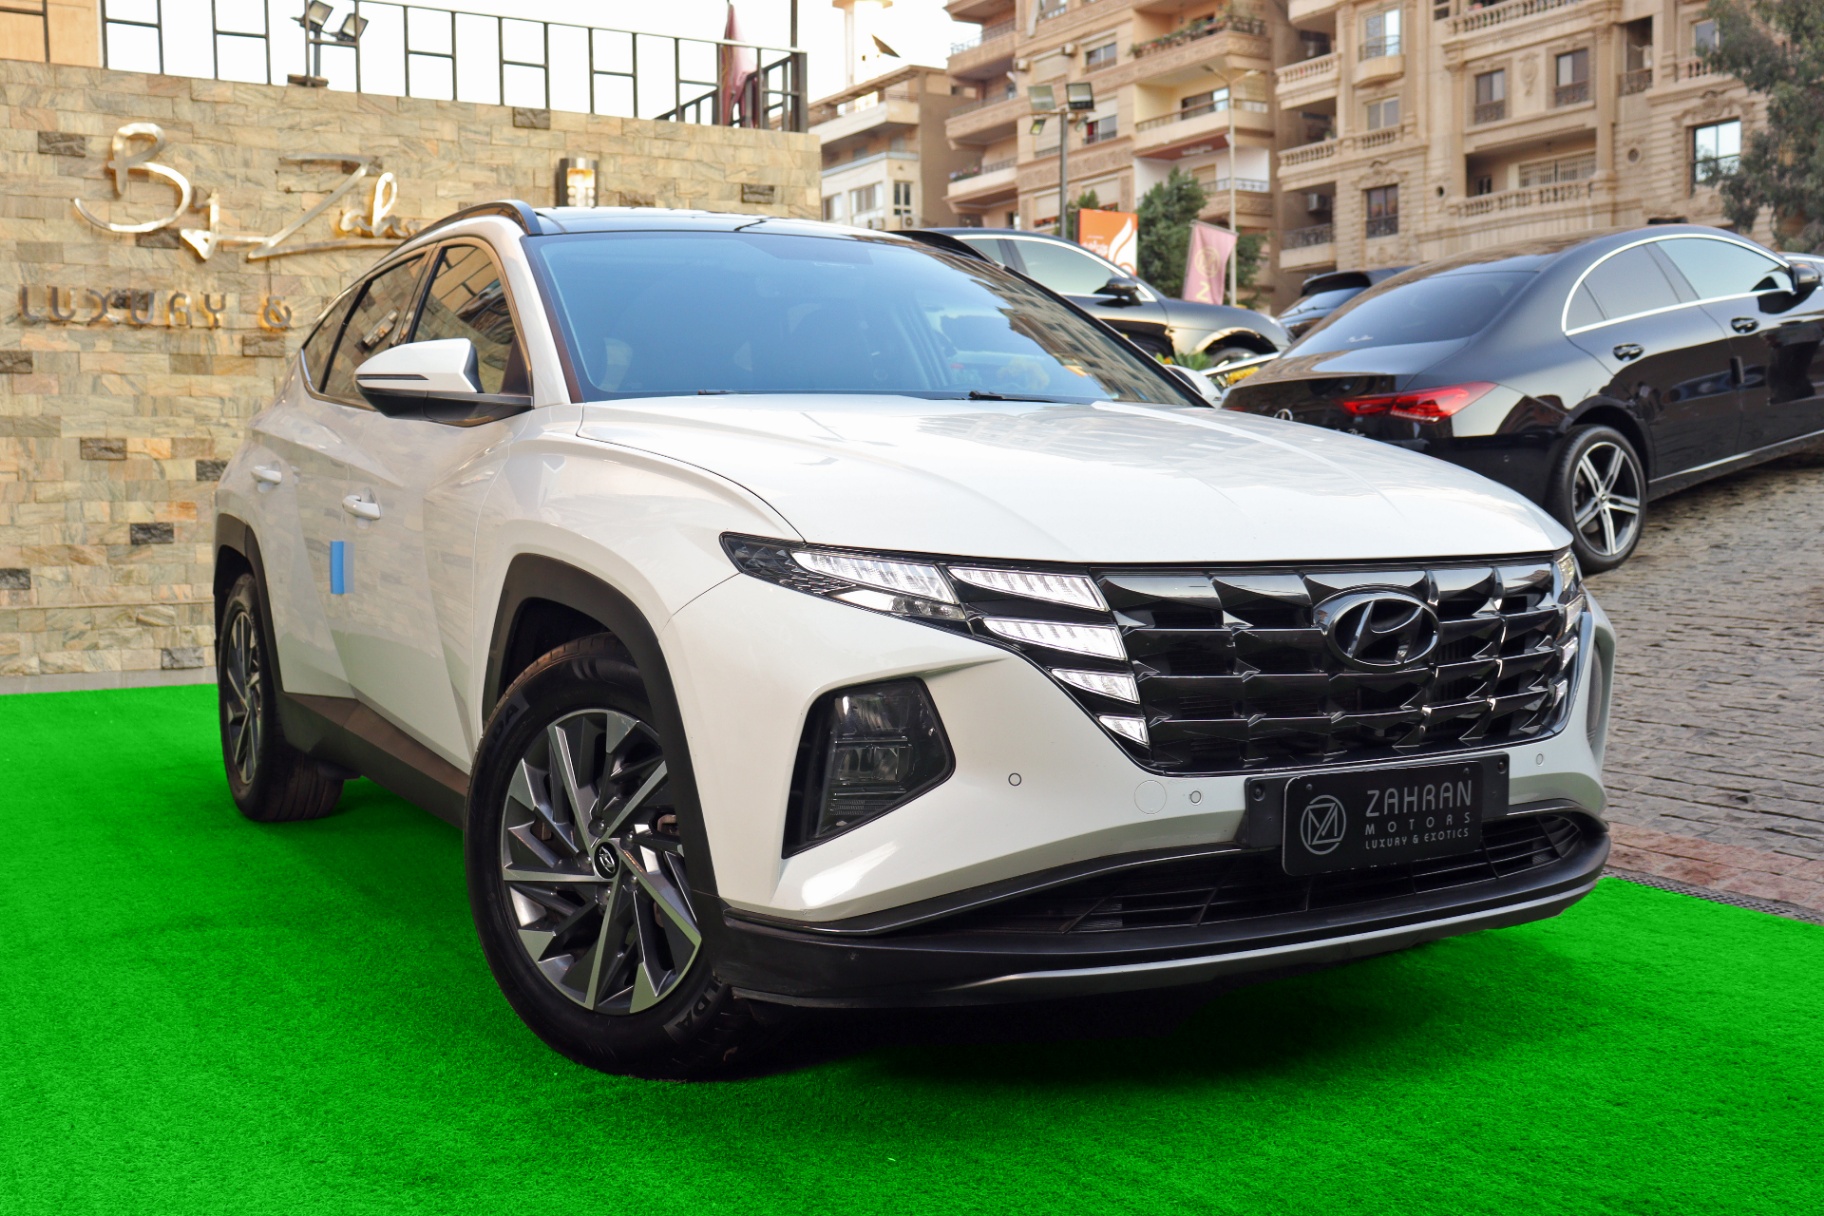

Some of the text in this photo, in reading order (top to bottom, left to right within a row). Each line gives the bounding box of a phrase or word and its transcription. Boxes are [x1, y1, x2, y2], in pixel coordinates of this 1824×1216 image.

[20, 285, 292, 329] LUXURY &
[1365, 780, 1472, 817] ZAHRAN
[1364, 812, 1471, 836] MOTORS
[1365, 828, 1470, 850] LUXURY & EXOTICS
